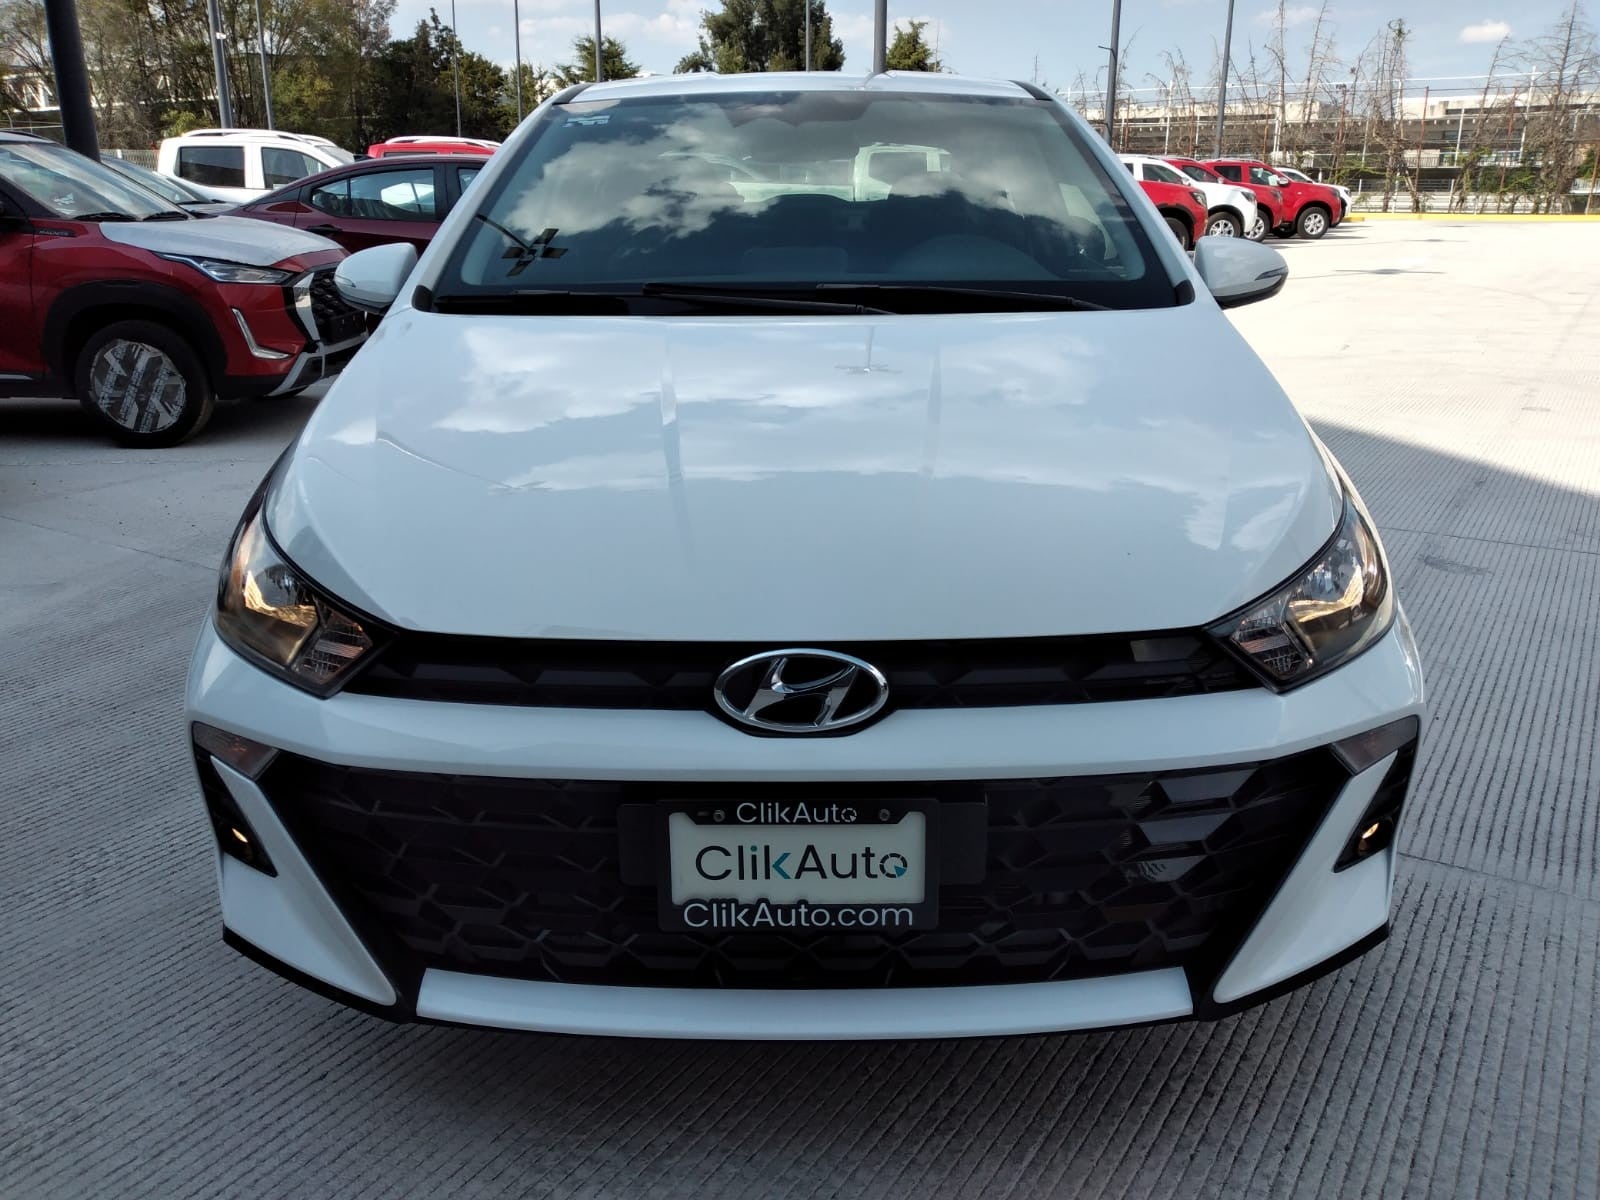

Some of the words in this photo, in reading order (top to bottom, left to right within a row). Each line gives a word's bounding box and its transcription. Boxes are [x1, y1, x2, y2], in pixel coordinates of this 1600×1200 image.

[736, 802, 857, 823] ClikAuto
[695, 845, 908, 880] ClikAuto
[683, 902, 913, 927] ClikAuto.com
